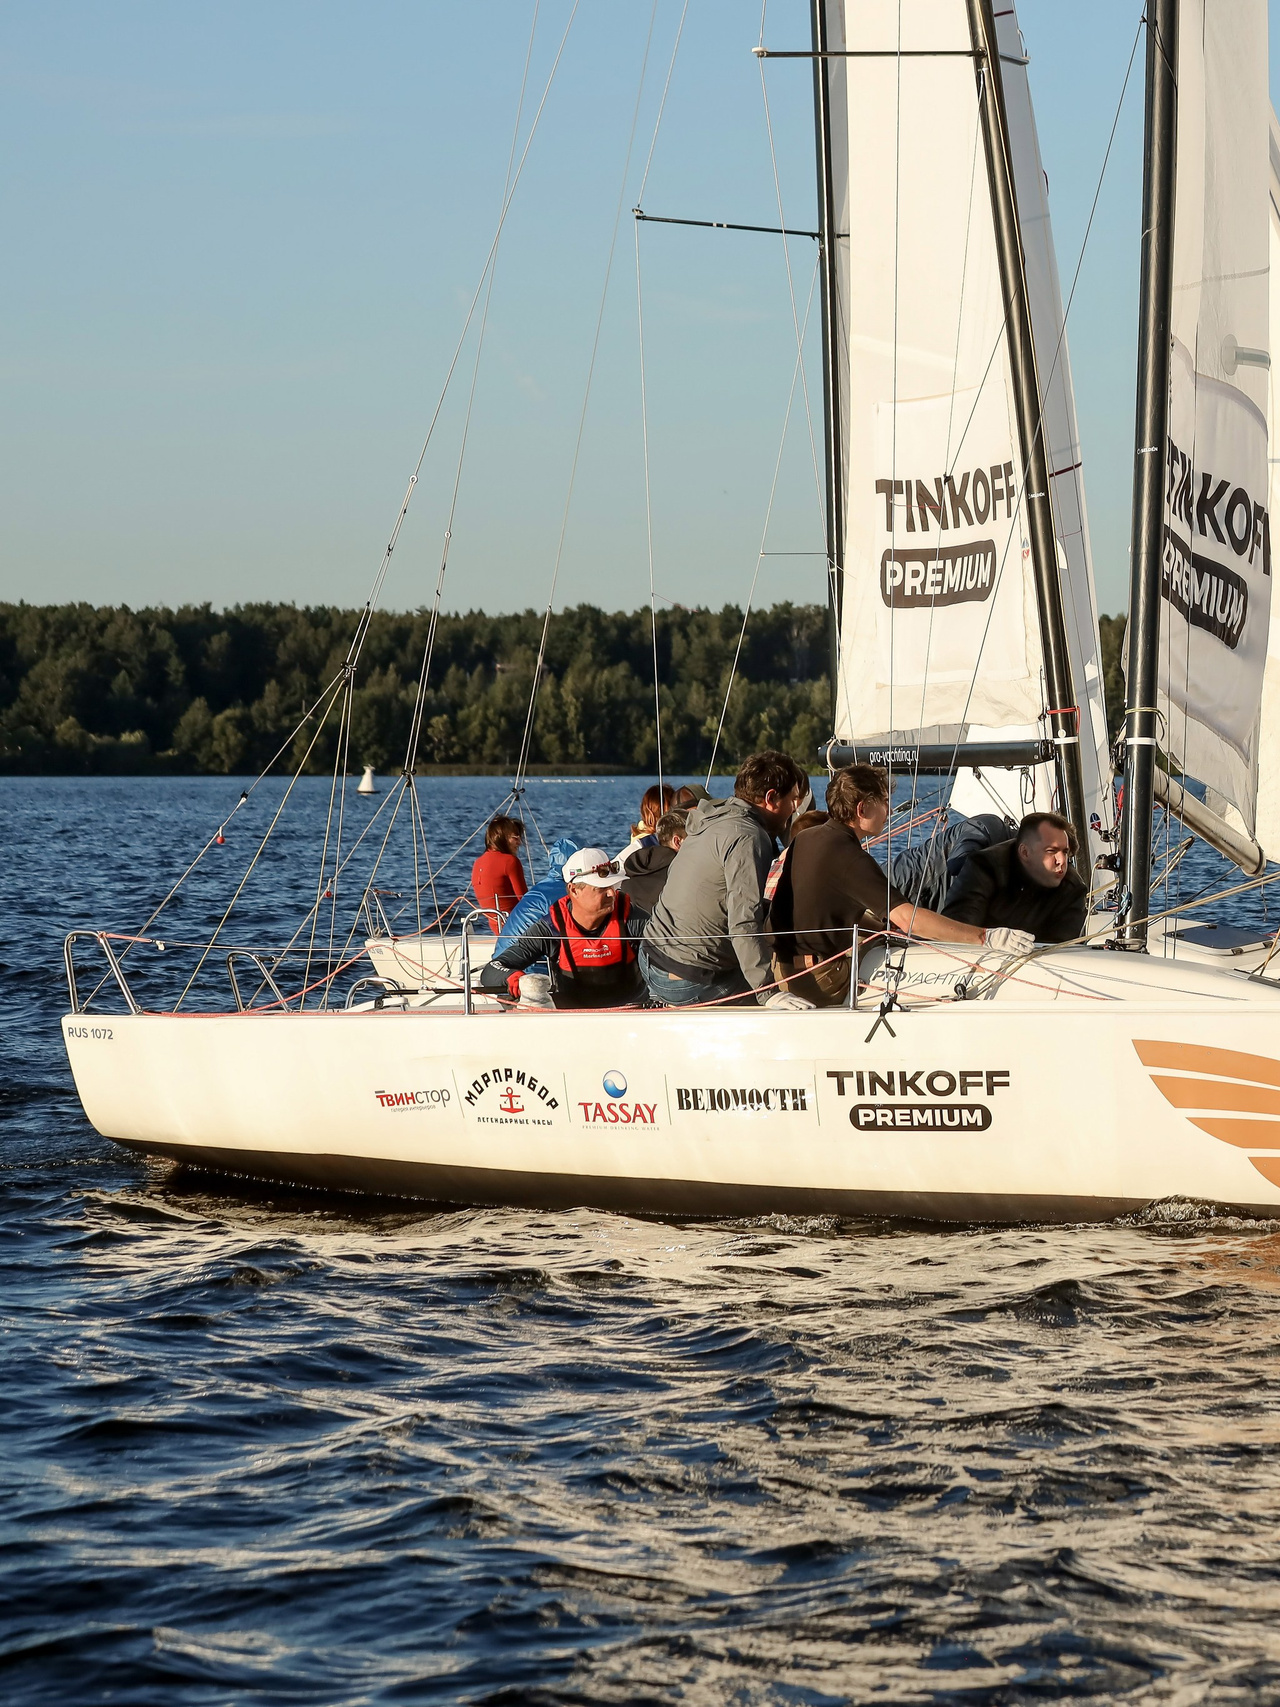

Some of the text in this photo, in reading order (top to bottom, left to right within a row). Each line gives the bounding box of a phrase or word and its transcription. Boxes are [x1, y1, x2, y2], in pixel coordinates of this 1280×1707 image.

[875, 460, 1016, 532] TINKOFF
[885, 551, 993, 596] PREMIUM
[1162, 536, 1245, 635] PREMIUM
[869, 748, 920, 766] pro-yachting.ru
[67, 1027, 113, 1039] RUS 1072
[464, 1068, 559, 1109] МОРПРИБОР
[826, 1070, 1010, 1096] TINKOFF
[577, 1102, 658, 1124] TASSAY
[676, 1088, 808, 1113] ВЕДОМОСТИ
[858, 1108, 983, 1126] PREMIUM
